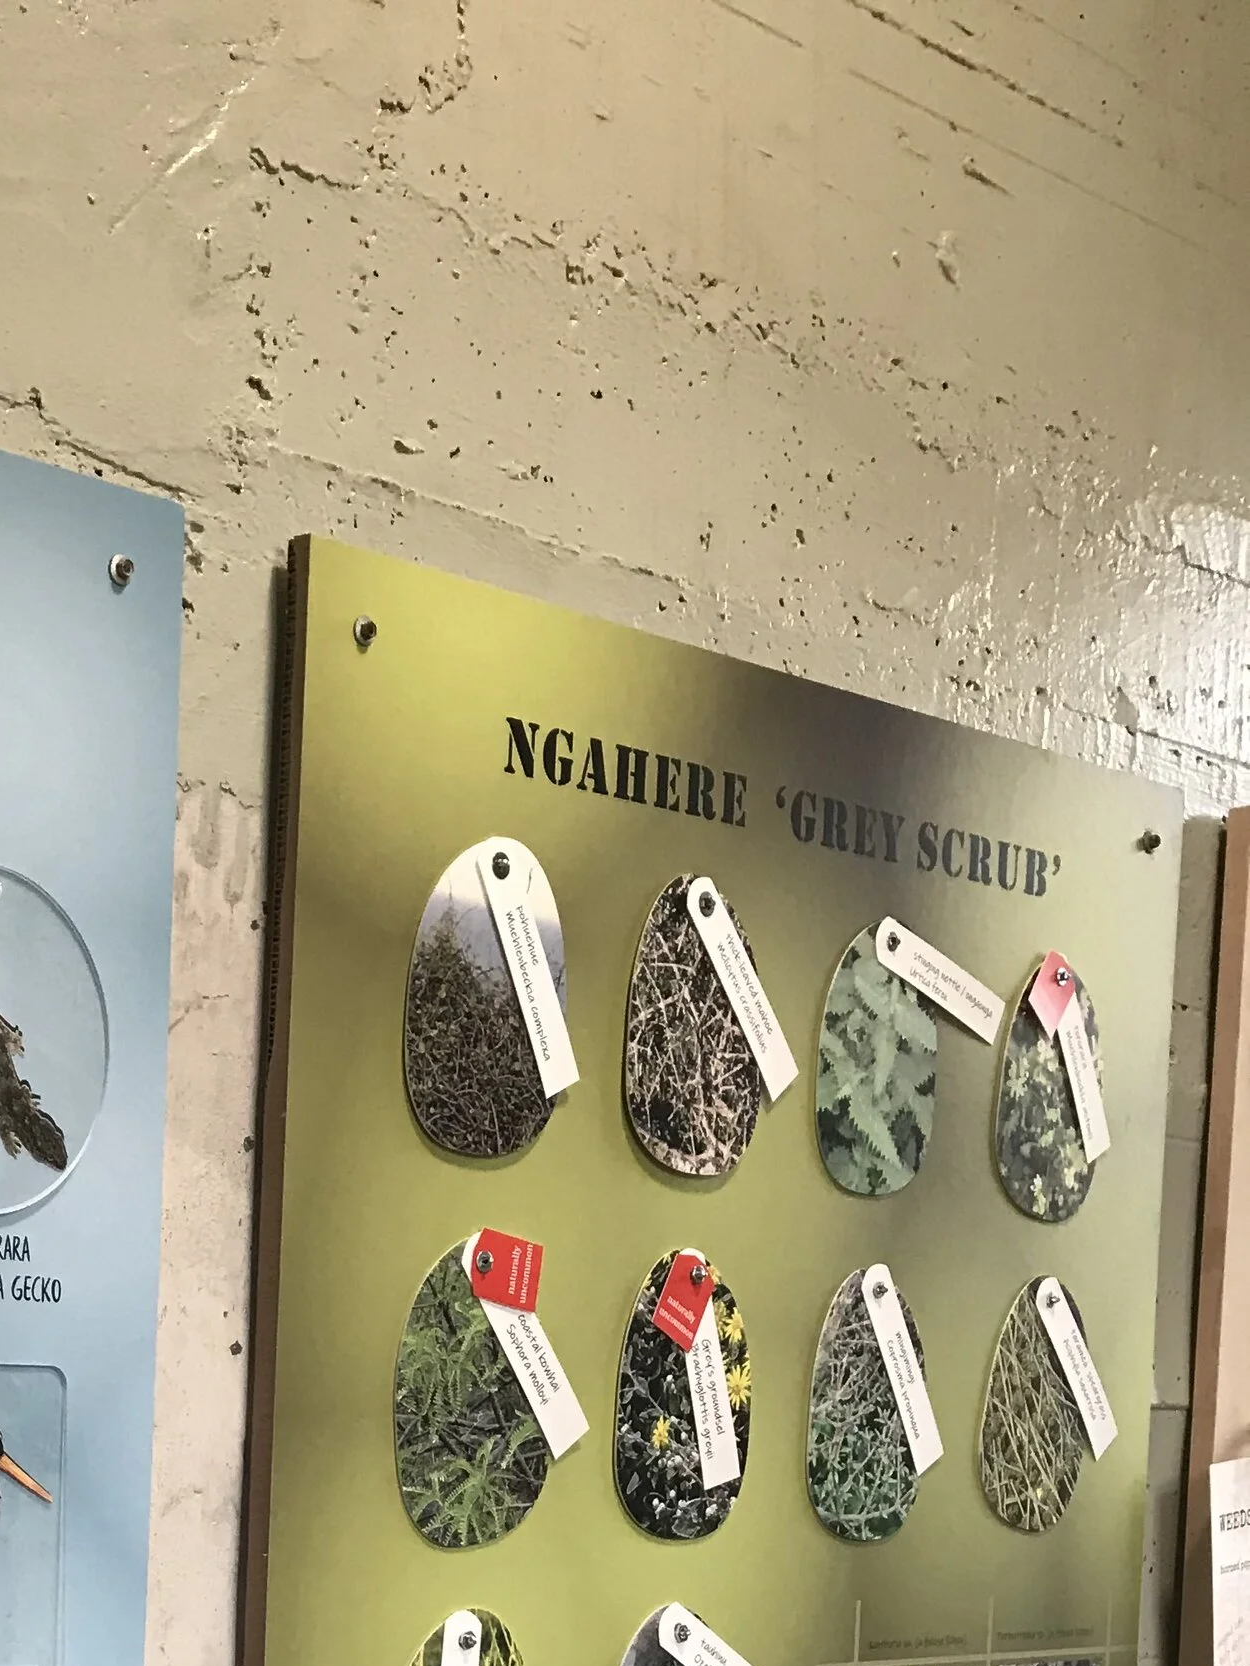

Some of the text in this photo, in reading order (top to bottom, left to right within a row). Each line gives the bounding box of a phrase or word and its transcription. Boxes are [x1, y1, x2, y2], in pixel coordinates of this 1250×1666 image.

[503, 716, 748, 828] NGAHERE
[531, 1005, 551, 1062] complexa
[11, 1275, 62, 1304] GECKO
[508, 1244, 523, 1295] naturally
[519, 1243, 534, 1304] uncommon
[506, 1323, 532, 1370] Sophora
[517, 1313, 562, 1393] coastal kowhai
[706, 1378, 727, 1436] groundsel
